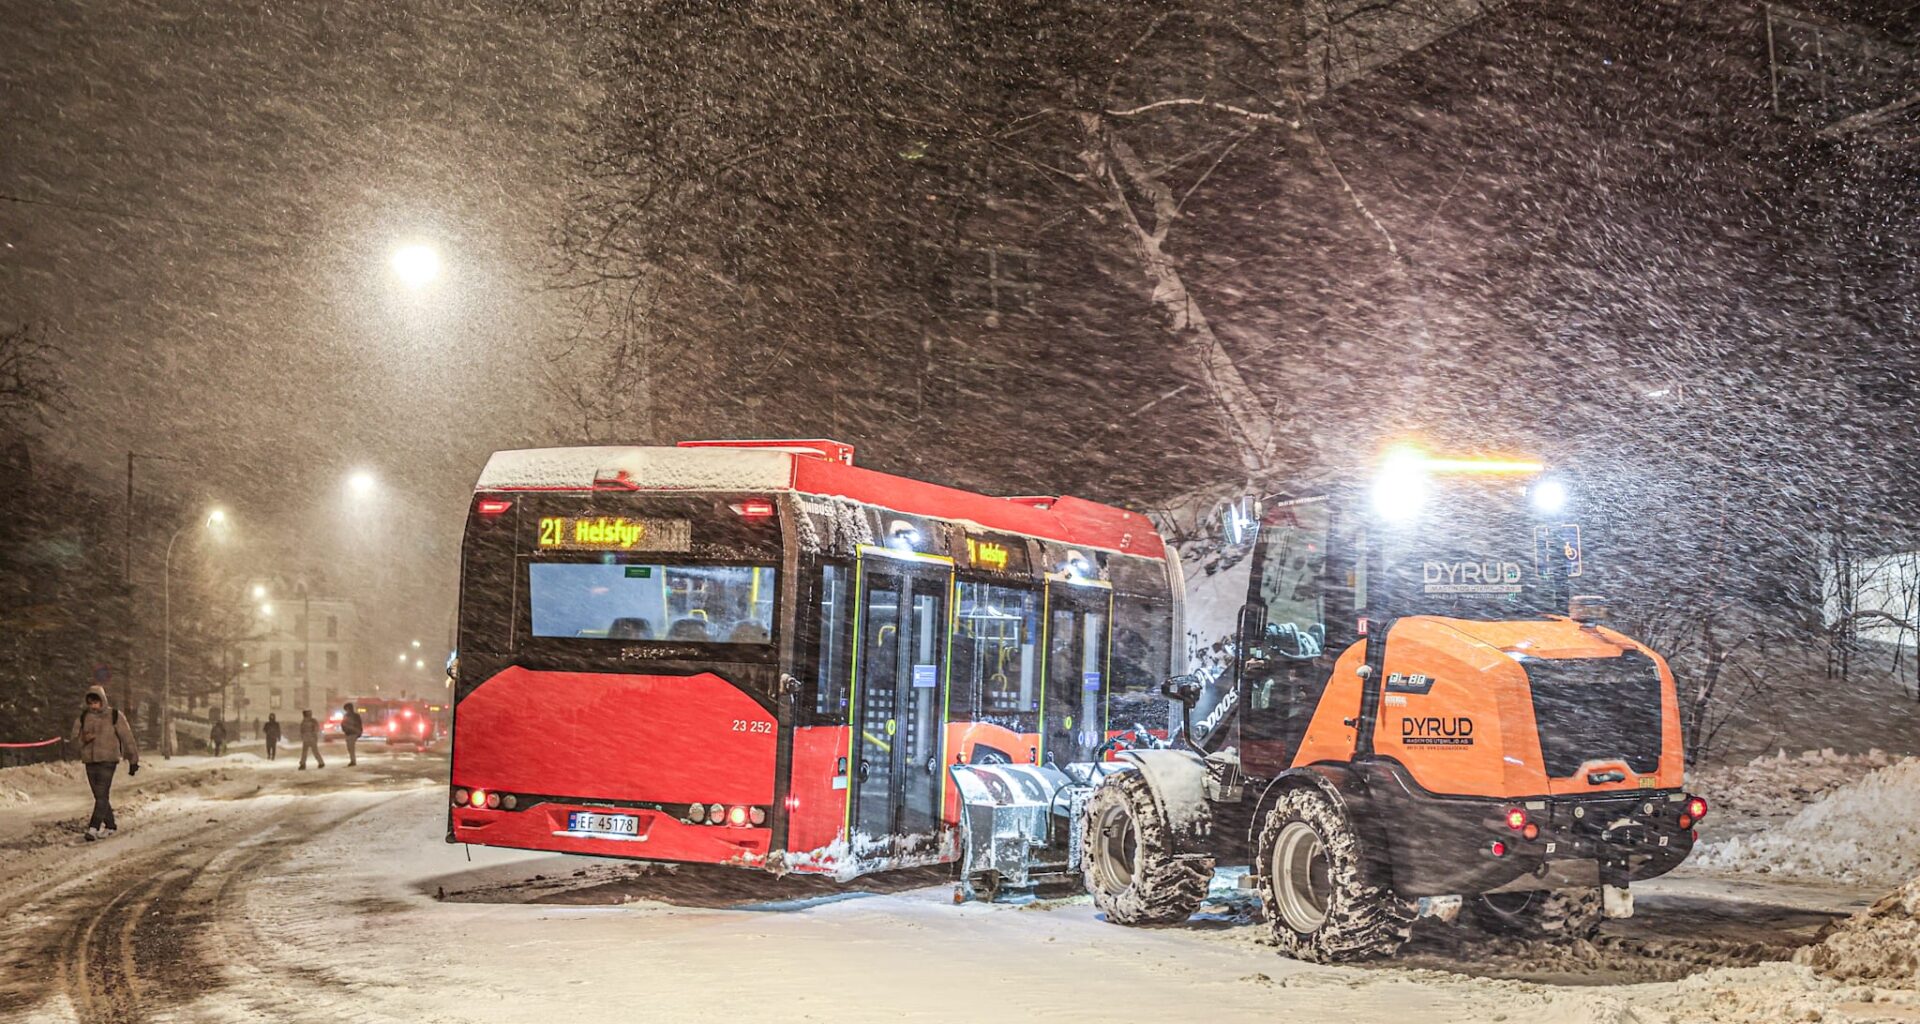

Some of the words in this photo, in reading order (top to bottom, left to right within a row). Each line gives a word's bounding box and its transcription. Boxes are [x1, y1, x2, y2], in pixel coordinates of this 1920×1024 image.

[540, 518, 561, 545] 21
[576, 518, 642, 548] Helsfyr
[1423, 561, 1521, 584] DYRUD
[1207, 685, 1240, 732] DOOS
[732, 719, 747, 732] 23
[750, 720, 772, 734] 252
[1402, 717, 1473, 736] DYRUD
[580, 815, 595, 829] EF
[598, 817, 633, 832] 45178
